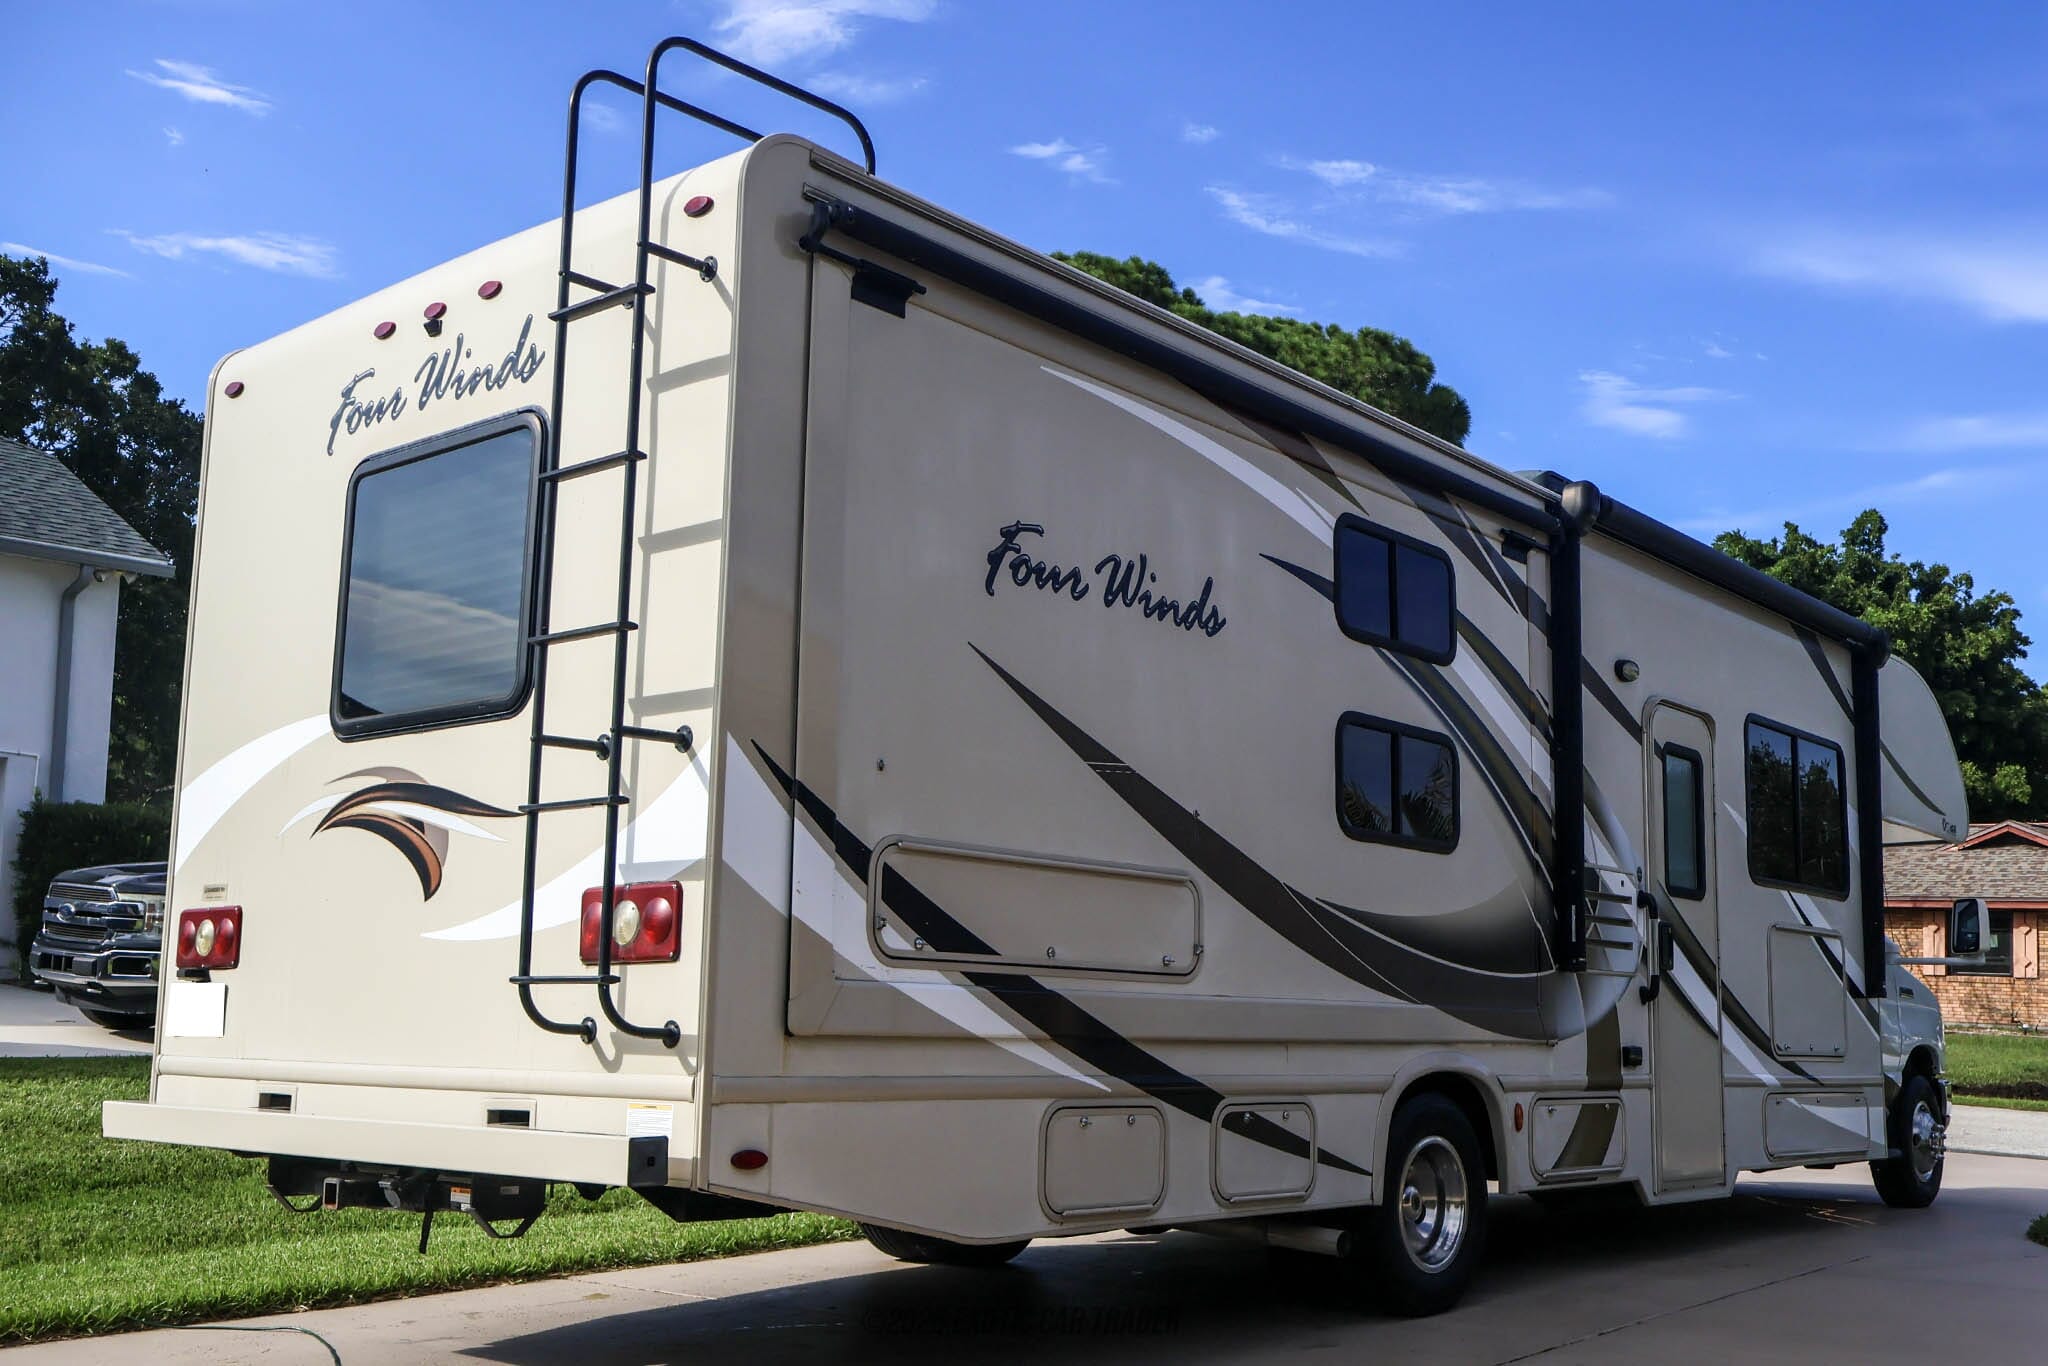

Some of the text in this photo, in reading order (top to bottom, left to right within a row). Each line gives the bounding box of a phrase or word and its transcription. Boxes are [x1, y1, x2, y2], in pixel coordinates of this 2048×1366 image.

[327, 313, 546, 456] Four Winds
[985, 519, 1227, 637] Four Winds
